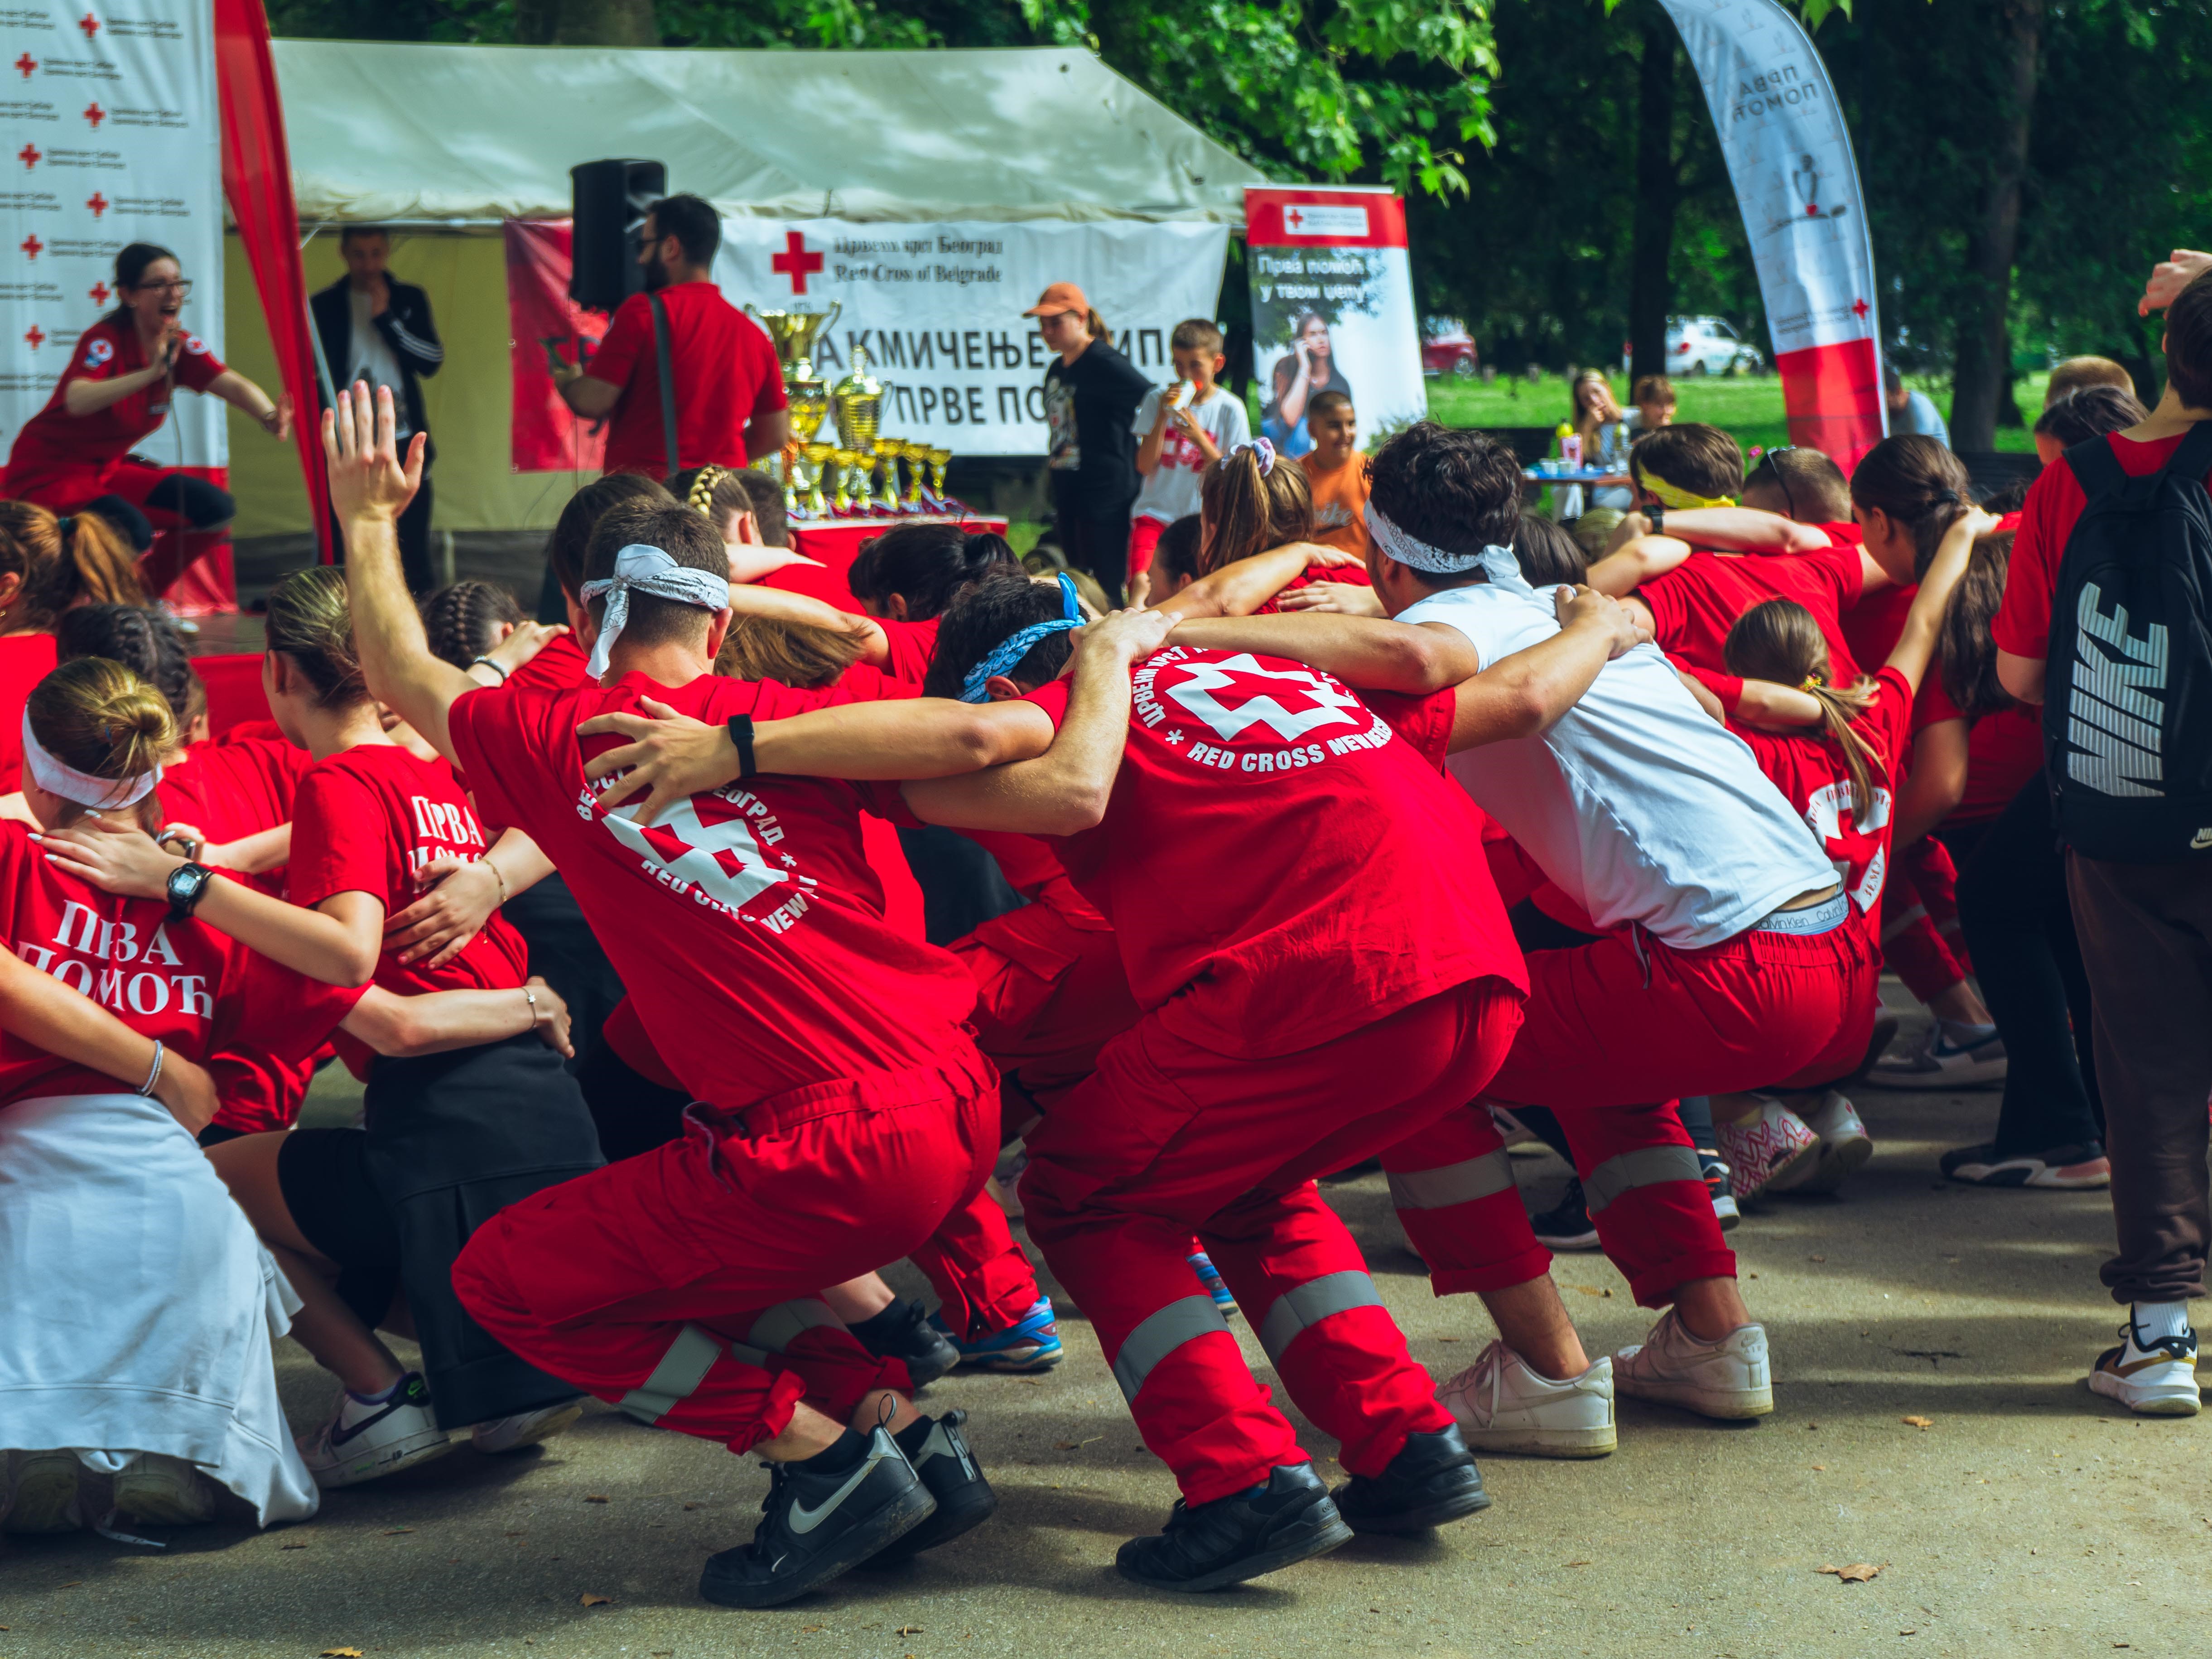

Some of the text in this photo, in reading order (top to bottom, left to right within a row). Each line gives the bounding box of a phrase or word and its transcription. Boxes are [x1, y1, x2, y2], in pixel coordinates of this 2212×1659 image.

[834, 264, 1002, 287] Red Cross of Belgrade
[815, 329, 1047, 371] АКМИЧЕЊЕ
[896, 386, 987, 425] ПРВЕ
[2067, 582, 2168, 796] NIKE
[1187, 742, 1235, 769] RED
[1241, 744, 1325, 772] CROSS
[1326, 733, 1374, 756] NEW
[411, 796, 486, 848] ПРВА
[713, 786, 785, 846] ЕОГРАД
